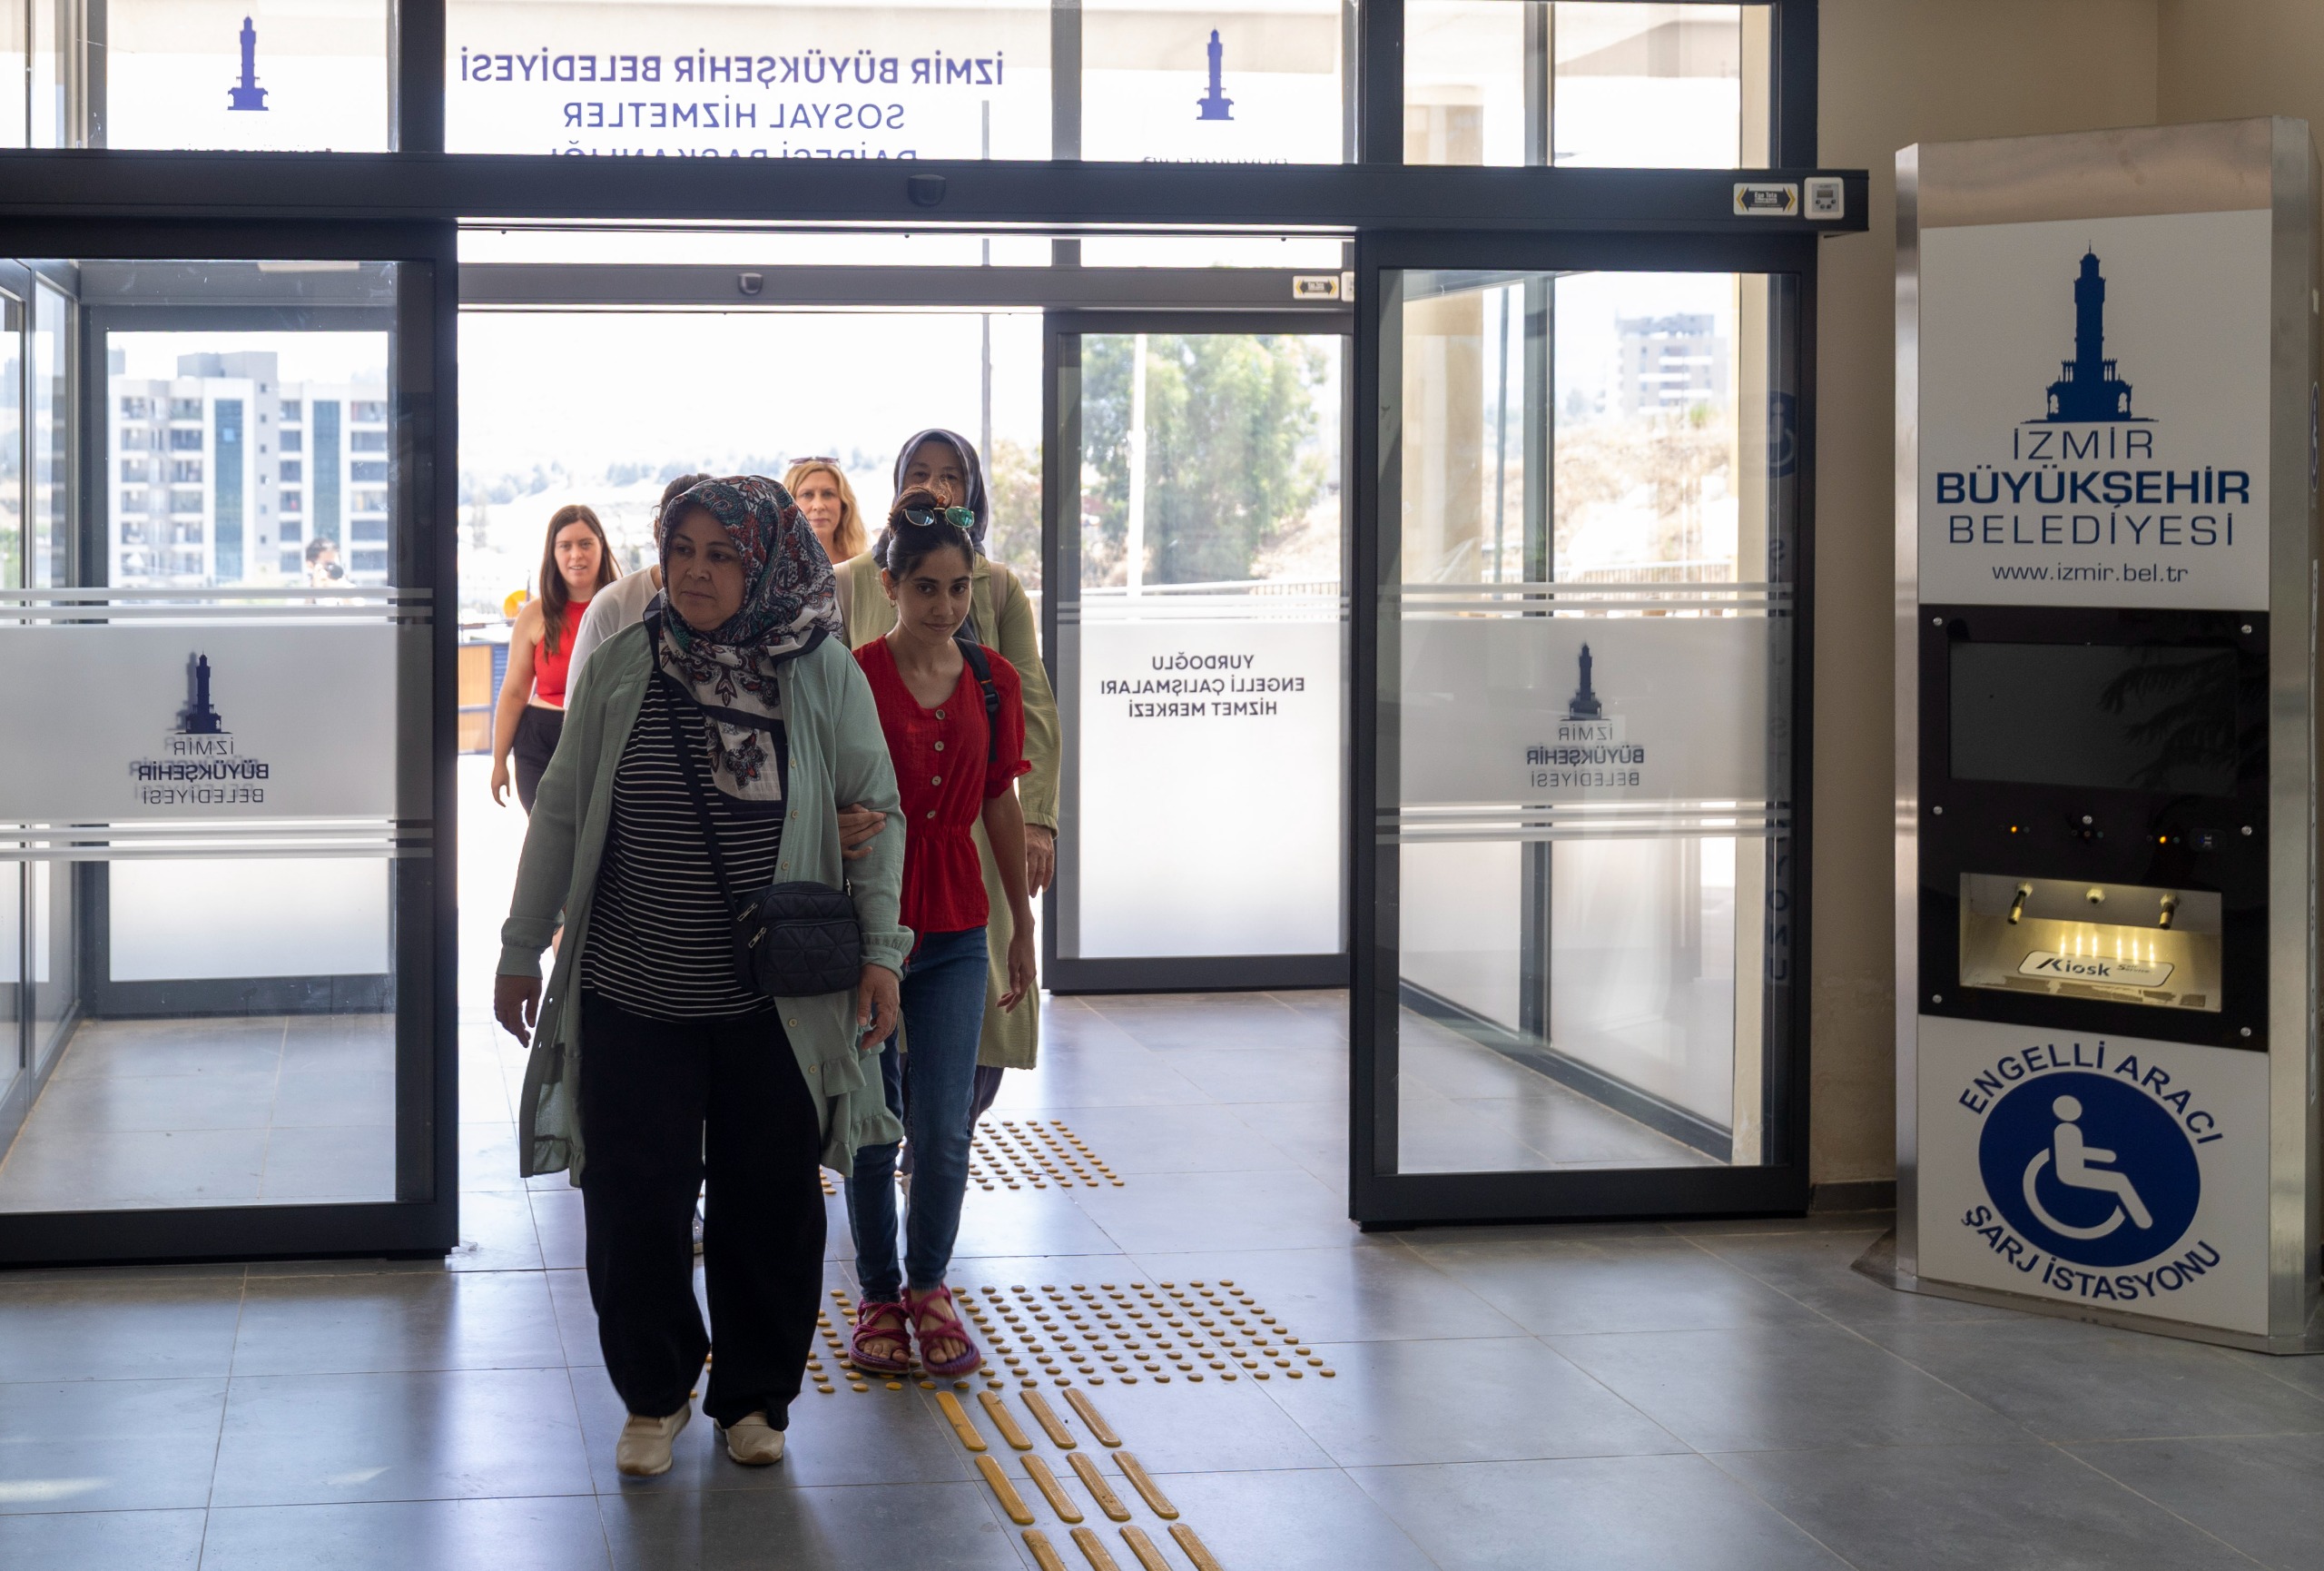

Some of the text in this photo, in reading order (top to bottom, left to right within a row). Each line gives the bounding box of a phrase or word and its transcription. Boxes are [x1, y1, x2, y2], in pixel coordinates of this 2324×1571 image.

[2013, 426, 2153, 460] İZMİR
[1936, 463, 2250, 509] BÜYÜKŞEHİR
[1949, 511, 2233, 547] BELEDİYESİ
[1992, 562, 2189, 583] www.izmir.bel.tr
[2035, 957, 2112, 977] Kiosk
[1958, 1041, 2223, 1144] ENGELLİ ARACI
[1961, 1204, 2221, 1301] ŞARJ İSTASYONU
